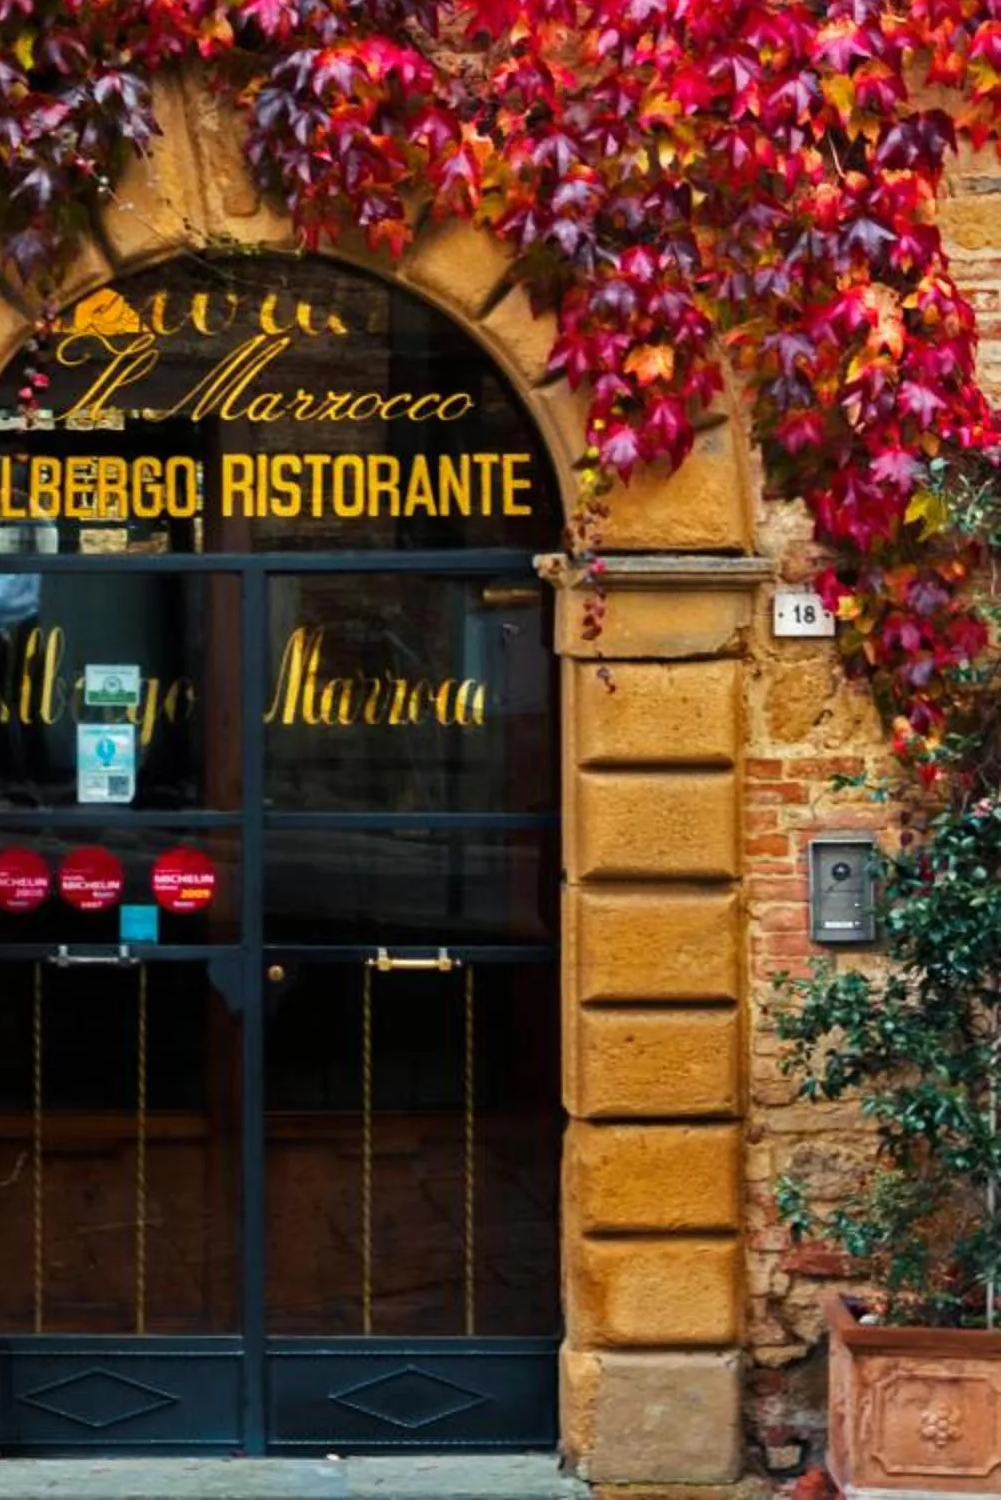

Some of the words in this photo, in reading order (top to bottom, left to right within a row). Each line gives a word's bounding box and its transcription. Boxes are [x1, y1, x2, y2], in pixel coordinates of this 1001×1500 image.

[52, 332, 159, 422] Il
[161, 334, 475, 422] Marzocco
[222, 453, 533, 518] RISTORANTE
[794, 605, 815, 624] 18
[62, 881, 120, 890] MICHELIN
[154, 875, 214, 884] MICHELIN
